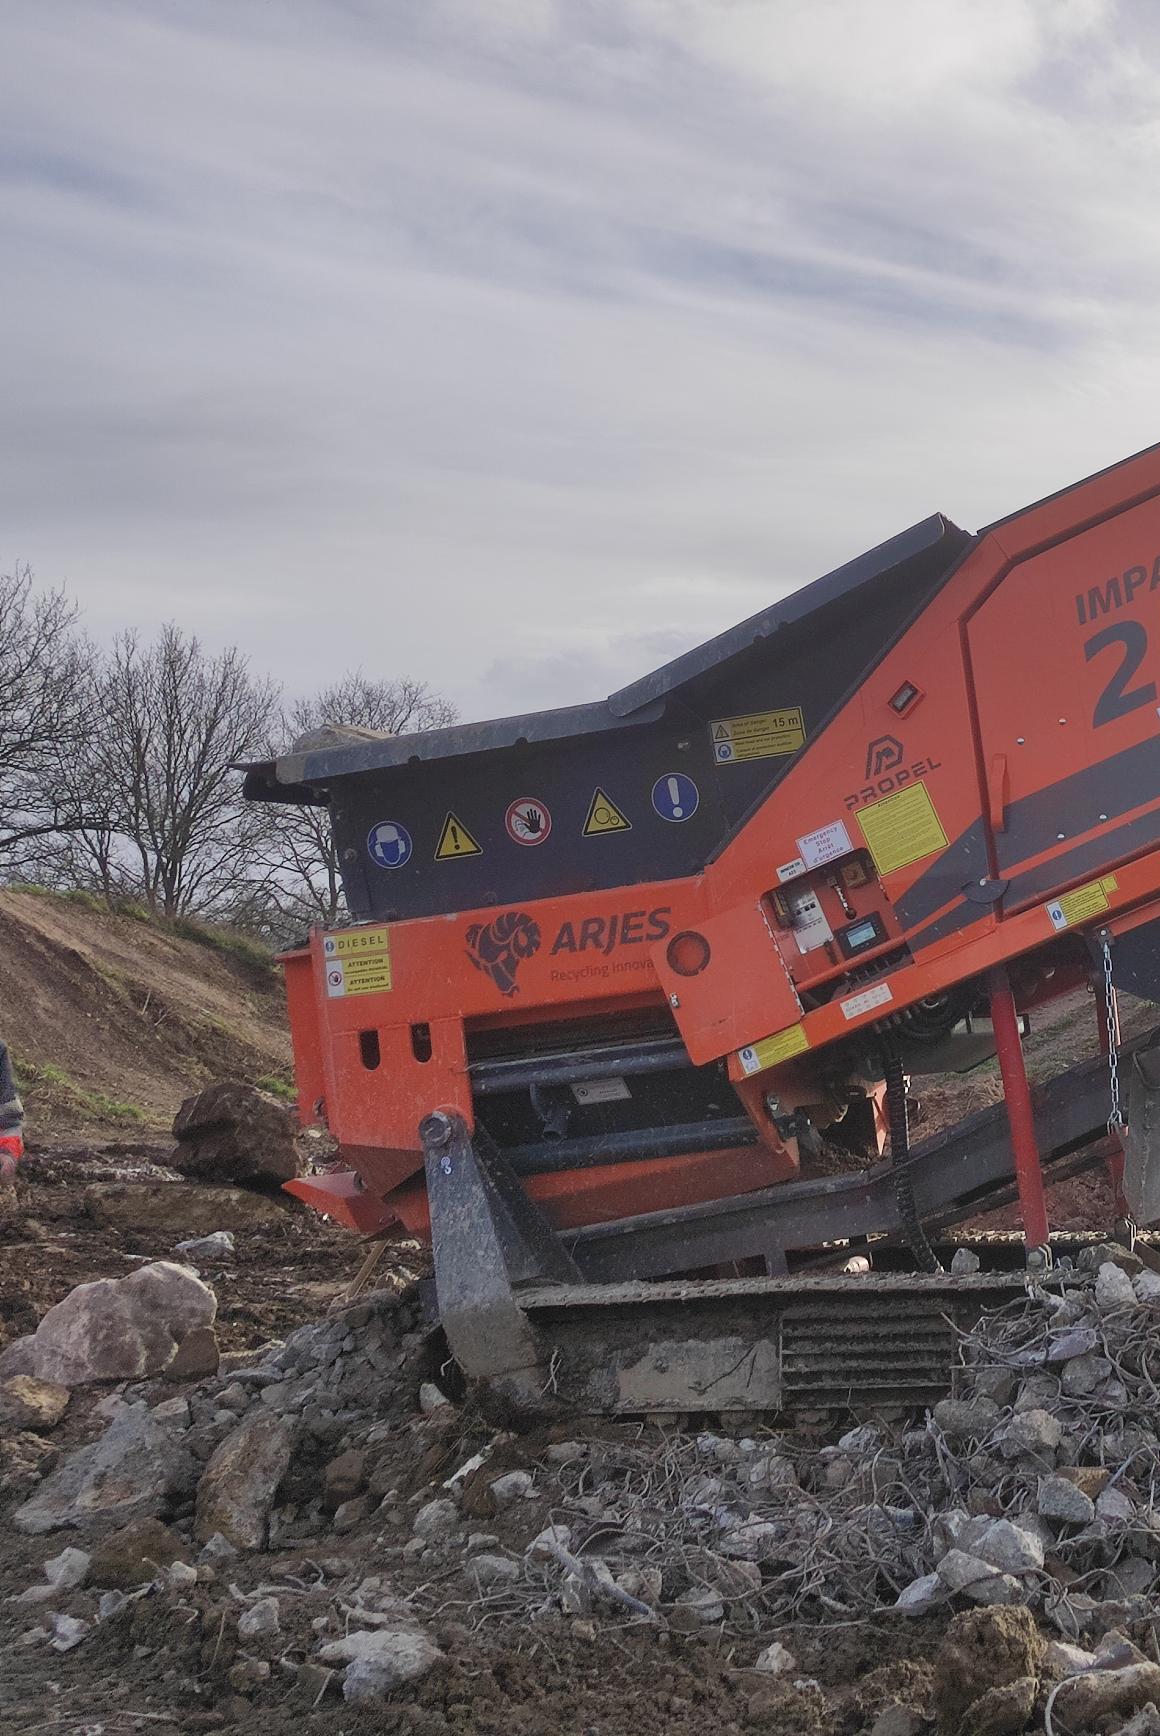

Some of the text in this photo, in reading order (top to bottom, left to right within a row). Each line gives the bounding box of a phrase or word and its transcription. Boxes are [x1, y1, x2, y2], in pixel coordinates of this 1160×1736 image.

[772, 716, 799, 728] 15 m
[844, 757, 942, 811] PROPEL
[803, 826, 838, 845] Emergency
[815, 837, 831, 847] Stop
[549, 906, 671, 956] ARJES
[338, 935, 384, 949] DIESEL
[347, 958, 384, 968] ATTENTION
[349, 976, 386, 986] ATTENTION
[550, 965, 610, 983] Recycling
